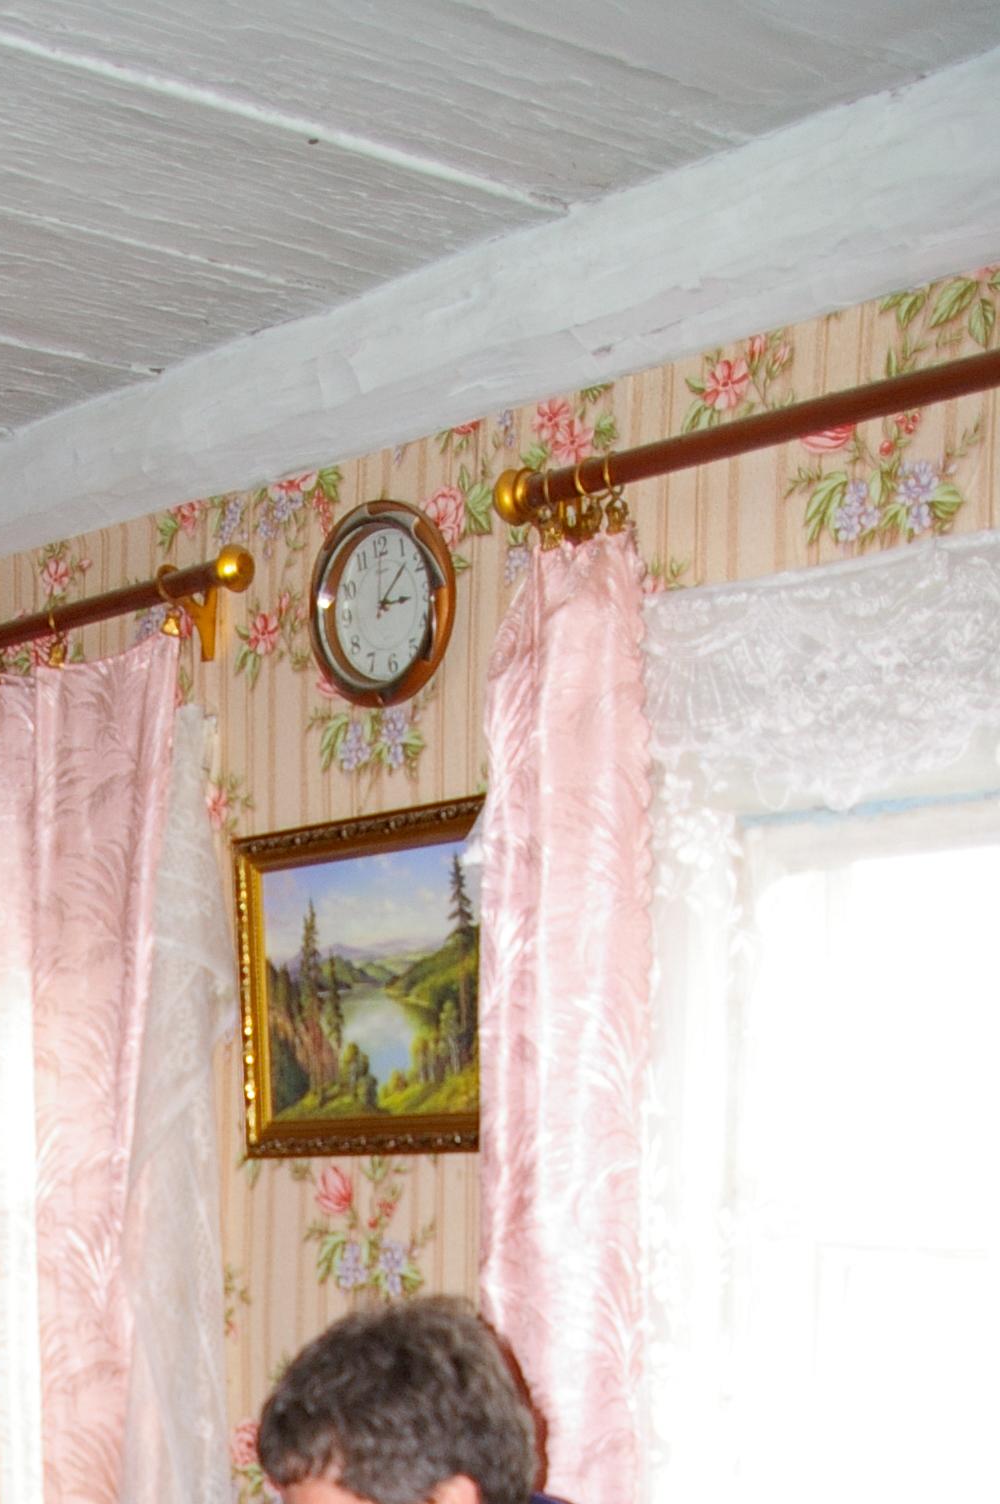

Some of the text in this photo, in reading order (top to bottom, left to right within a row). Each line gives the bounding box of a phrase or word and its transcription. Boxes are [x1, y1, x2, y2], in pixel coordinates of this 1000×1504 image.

[373, 536, 388, 558] 12
[399, 537, 406, 557] 1
[356, 550, 368, 572] 11
[343, 580, 357, 600] 10
[342, 607, 353, 629] 9
[350, 634, 361, 655] 8
[366, 651, 376, 673] 7
[387, 653, 399, 673] 6
